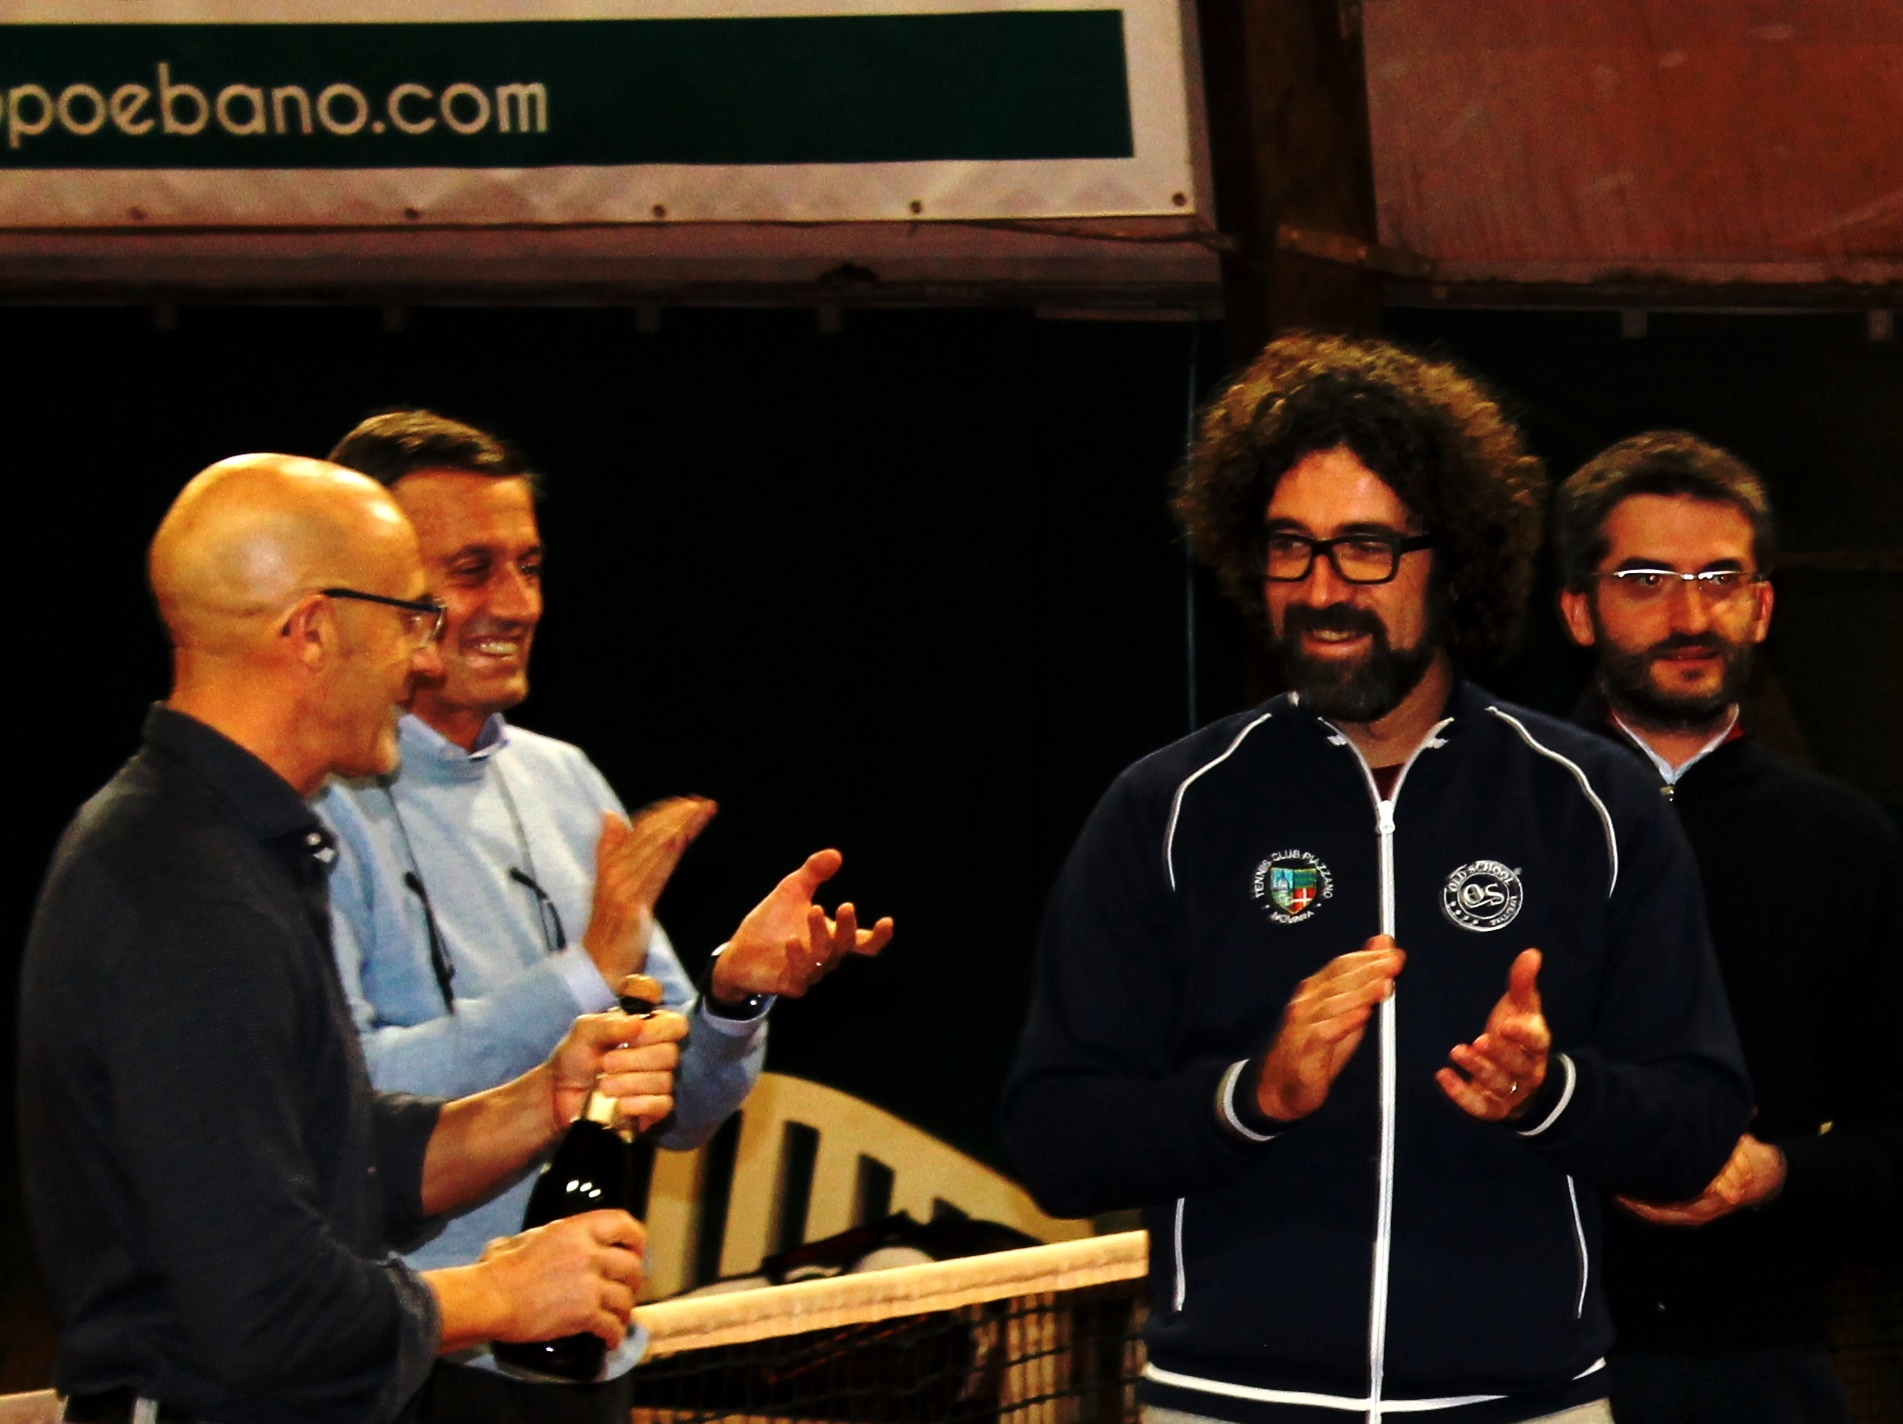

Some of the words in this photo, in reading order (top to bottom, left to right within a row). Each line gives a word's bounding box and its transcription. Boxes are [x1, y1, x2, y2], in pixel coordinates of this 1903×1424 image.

[0, 61, 548, 149] poebano.com
[1271, 849, 1301, 861] CLUB
[1447, 870, 1468, 892] OLD
